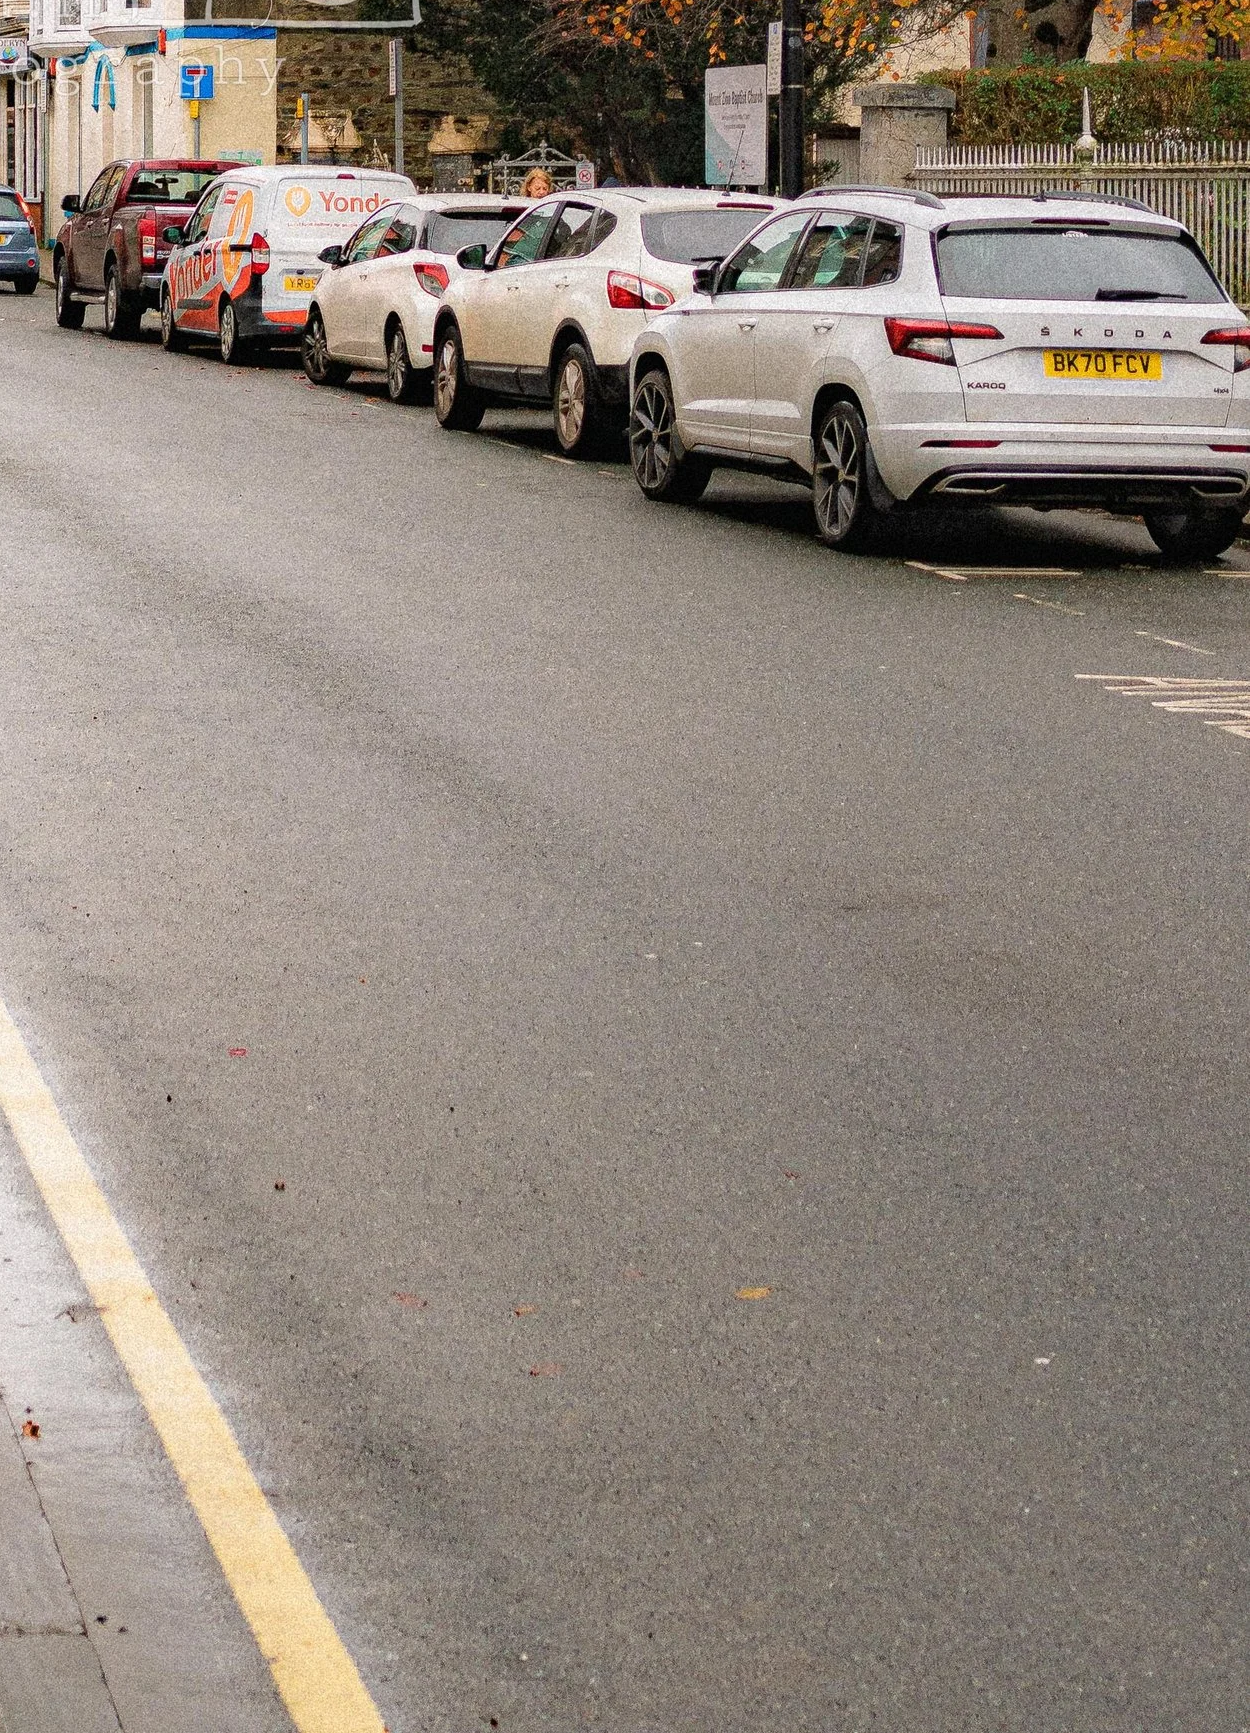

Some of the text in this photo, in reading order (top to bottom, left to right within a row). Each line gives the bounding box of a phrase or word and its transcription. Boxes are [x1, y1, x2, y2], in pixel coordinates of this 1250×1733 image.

[732, 90, 747, 109] Baptist
[748, 88, 763, 105] Church
[1052, 352, 1151, 374] BK70 FCV
[966, 382, 1006, 390] KAROQ
